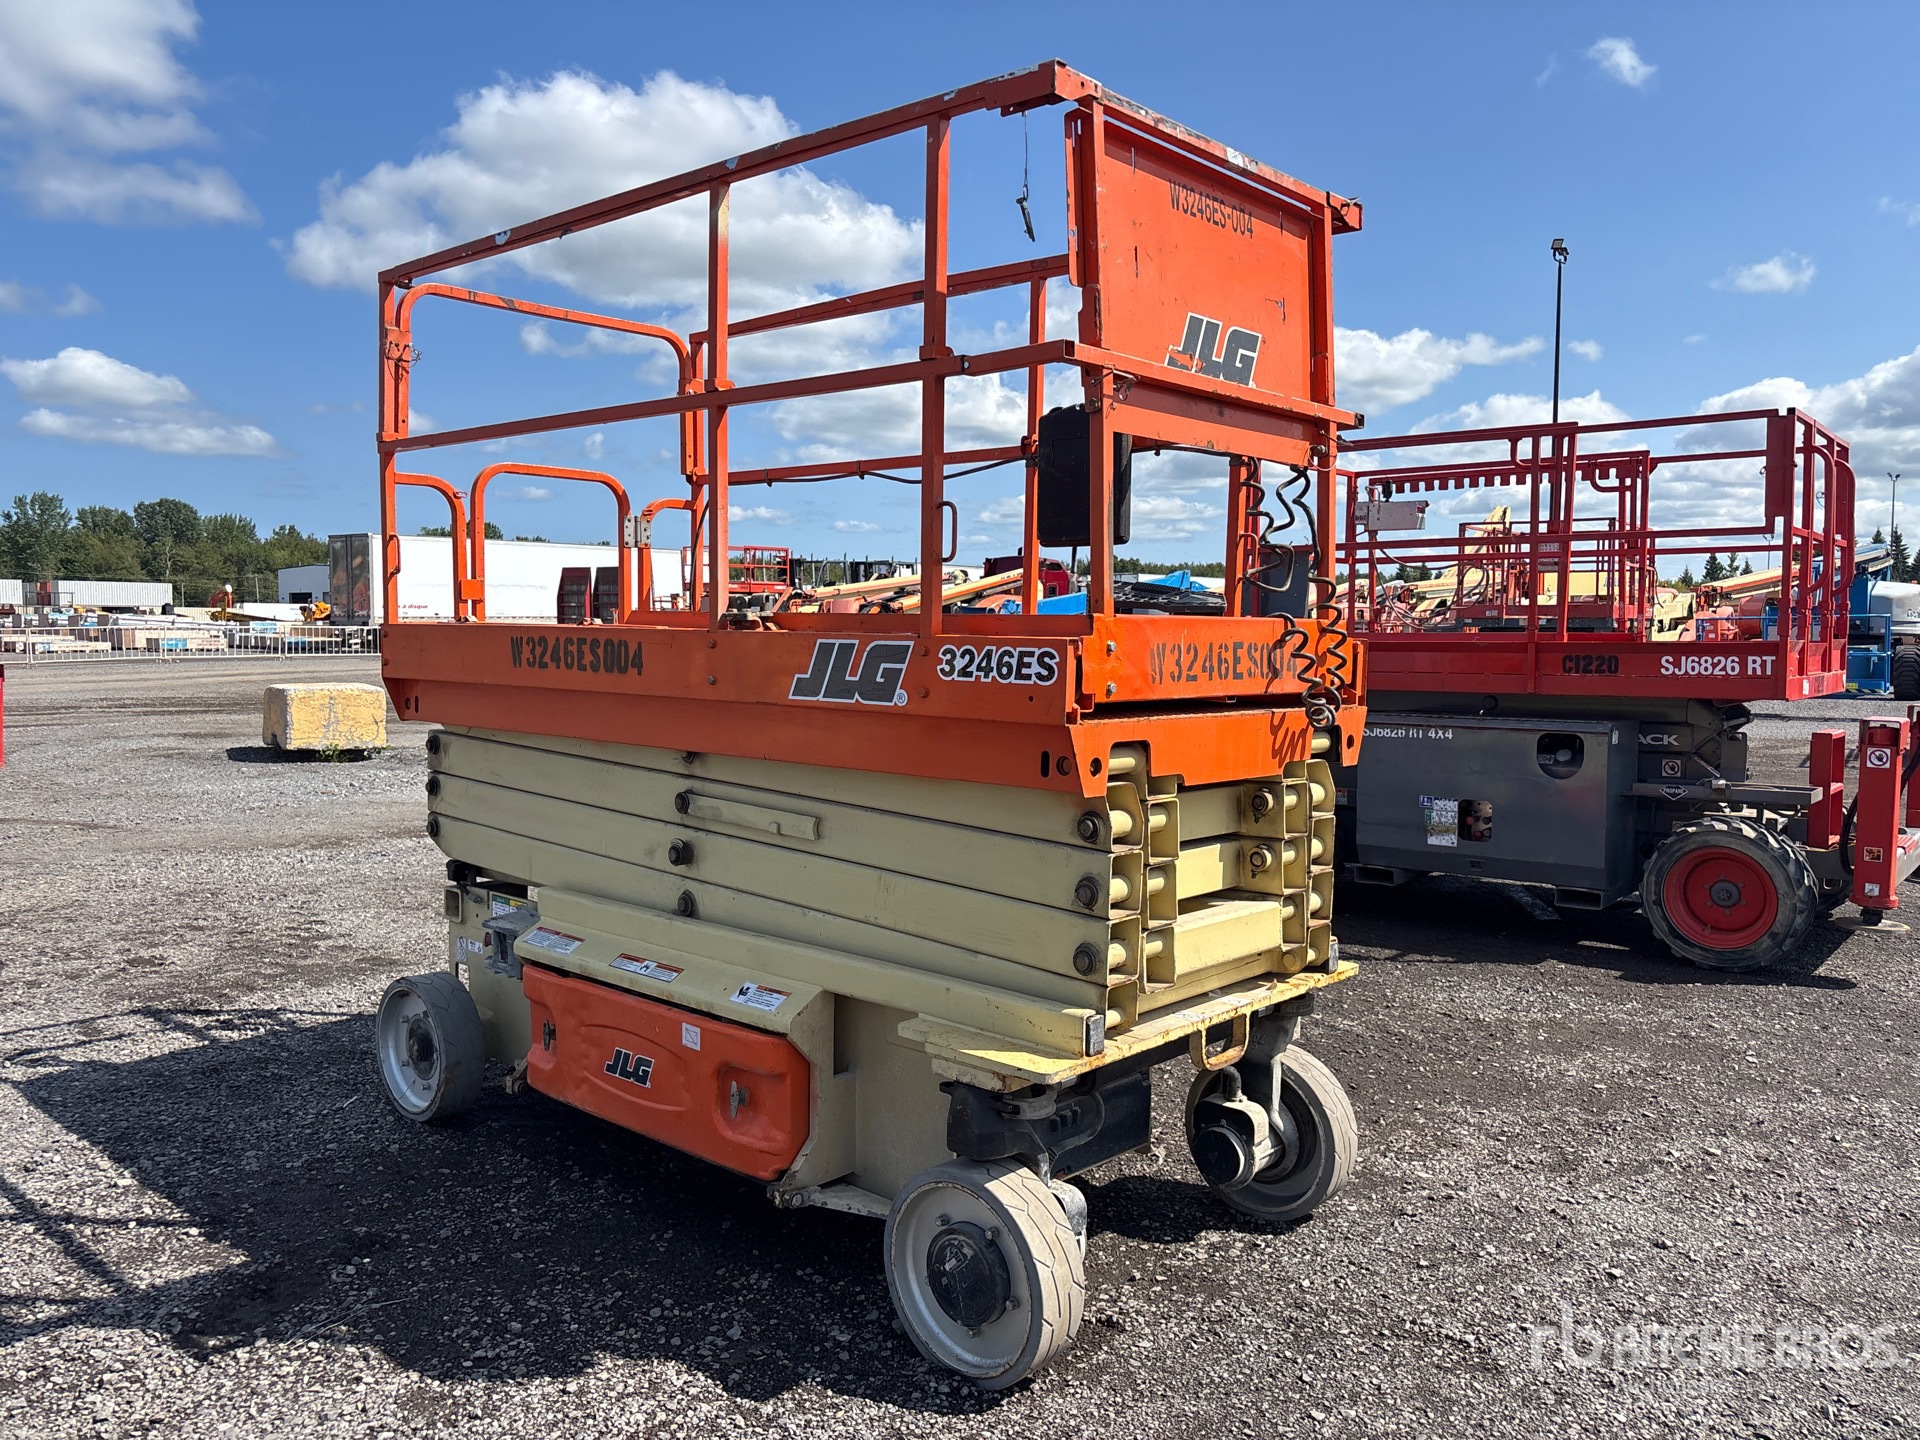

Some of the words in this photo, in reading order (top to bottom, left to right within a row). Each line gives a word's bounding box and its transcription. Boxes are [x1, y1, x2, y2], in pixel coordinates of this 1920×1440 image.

[1169, 178, 1254, 240] W3246ES-004
[1164, 312, 1262, 388] JLG
[510, 635, 644, 676] W3246ES004
[788, 638, 915, 706] JLG
[936, 644, 1061, 686] 3246ES
[1660, 655, 1741, 676] SJ6826
[1747, 655, 1777, 676] RT
[604, 1047, 655, 1088] JLG
